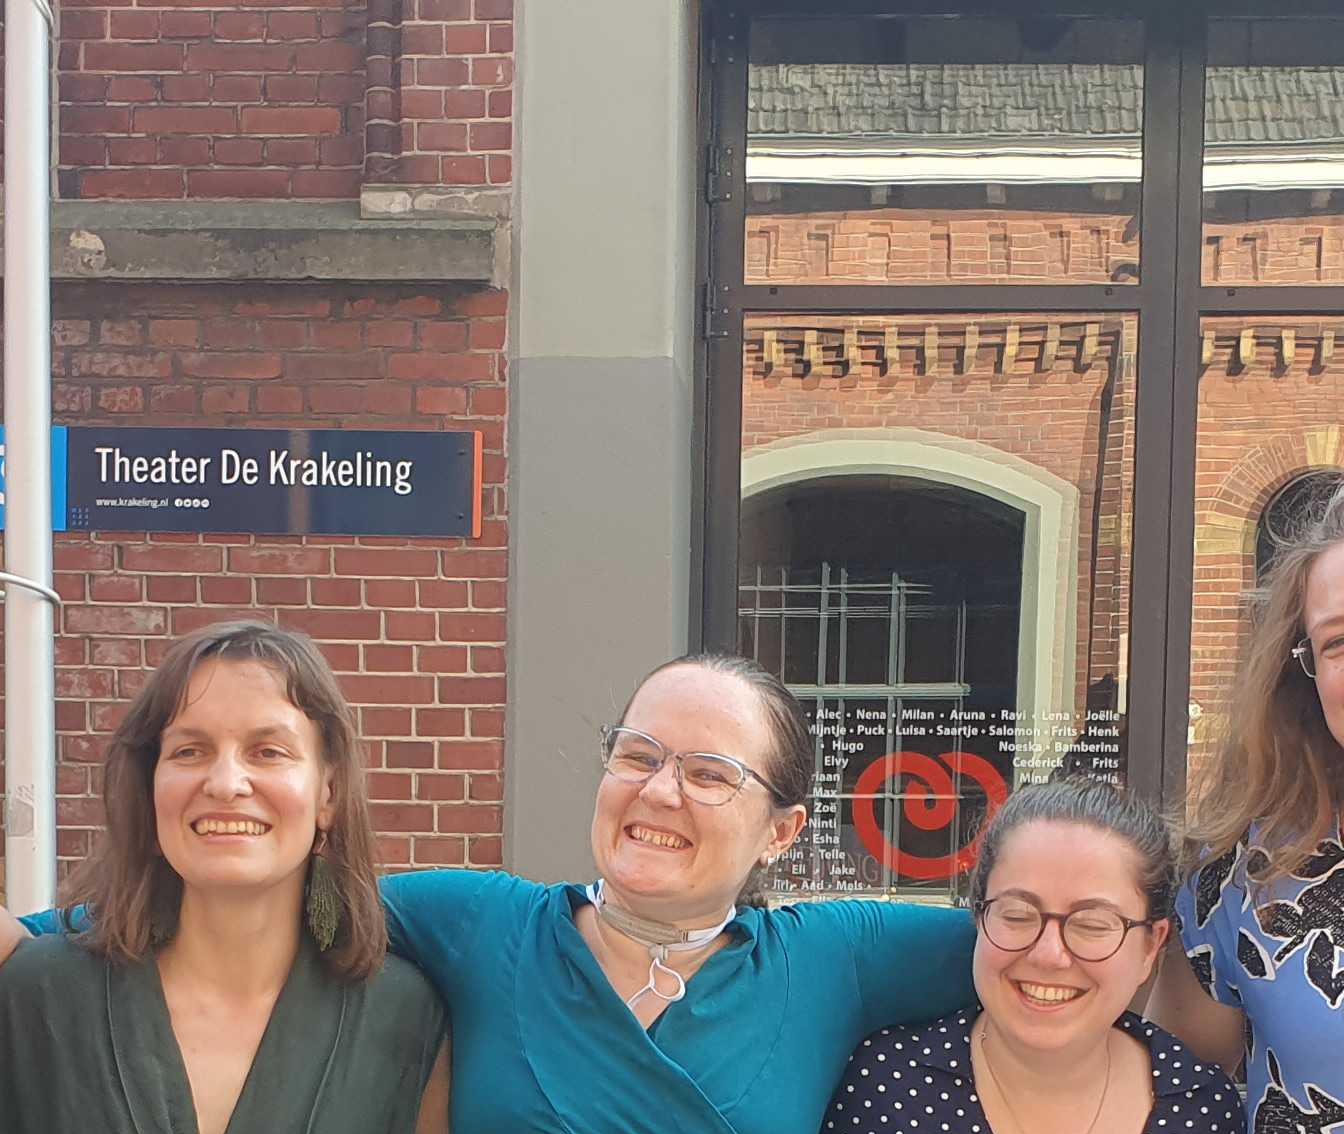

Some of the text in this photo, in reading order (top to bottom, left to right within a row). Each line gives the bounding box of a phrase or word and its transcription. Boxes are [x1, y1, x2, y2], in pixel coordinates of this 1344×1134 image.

[94, 447, 413, 494] Theater De Krakeling
[96, 497, 168, 509] www.krakeling.nl
[816, 709, 1120, 721] Alec Nena Milan Aruna Ravi Lena Joëlle
[857, 725, 885, 735] Puck
[896, 725, 926, 736] Luisa
[936, 725, 979, 738] Saartje
[989, 725, 1040, 736] Salomon
[1051, 726, 1077, 737] Frits
[1088, 726, 1119, 737] Henk
[832, 741, 864, 754] Hugo
[999, 741, 1119, 753] Noeska Bamberina
[824, 756, 849, 769] Elvy
[1012, 757, 1119, 769] Cederick Frits
[811, 771, 841, 782] riaan
[1019, 773, 1049, 784] Mina
[813, 787, 837, 798] Max
[814, 802, 837, 813] Zoë
[808, 817, 837, 829] Ninti
[812, 833, 840, 844] Esha
[829, 864, 856, 875] Jake
[801, 880, 824, 891] Aad
